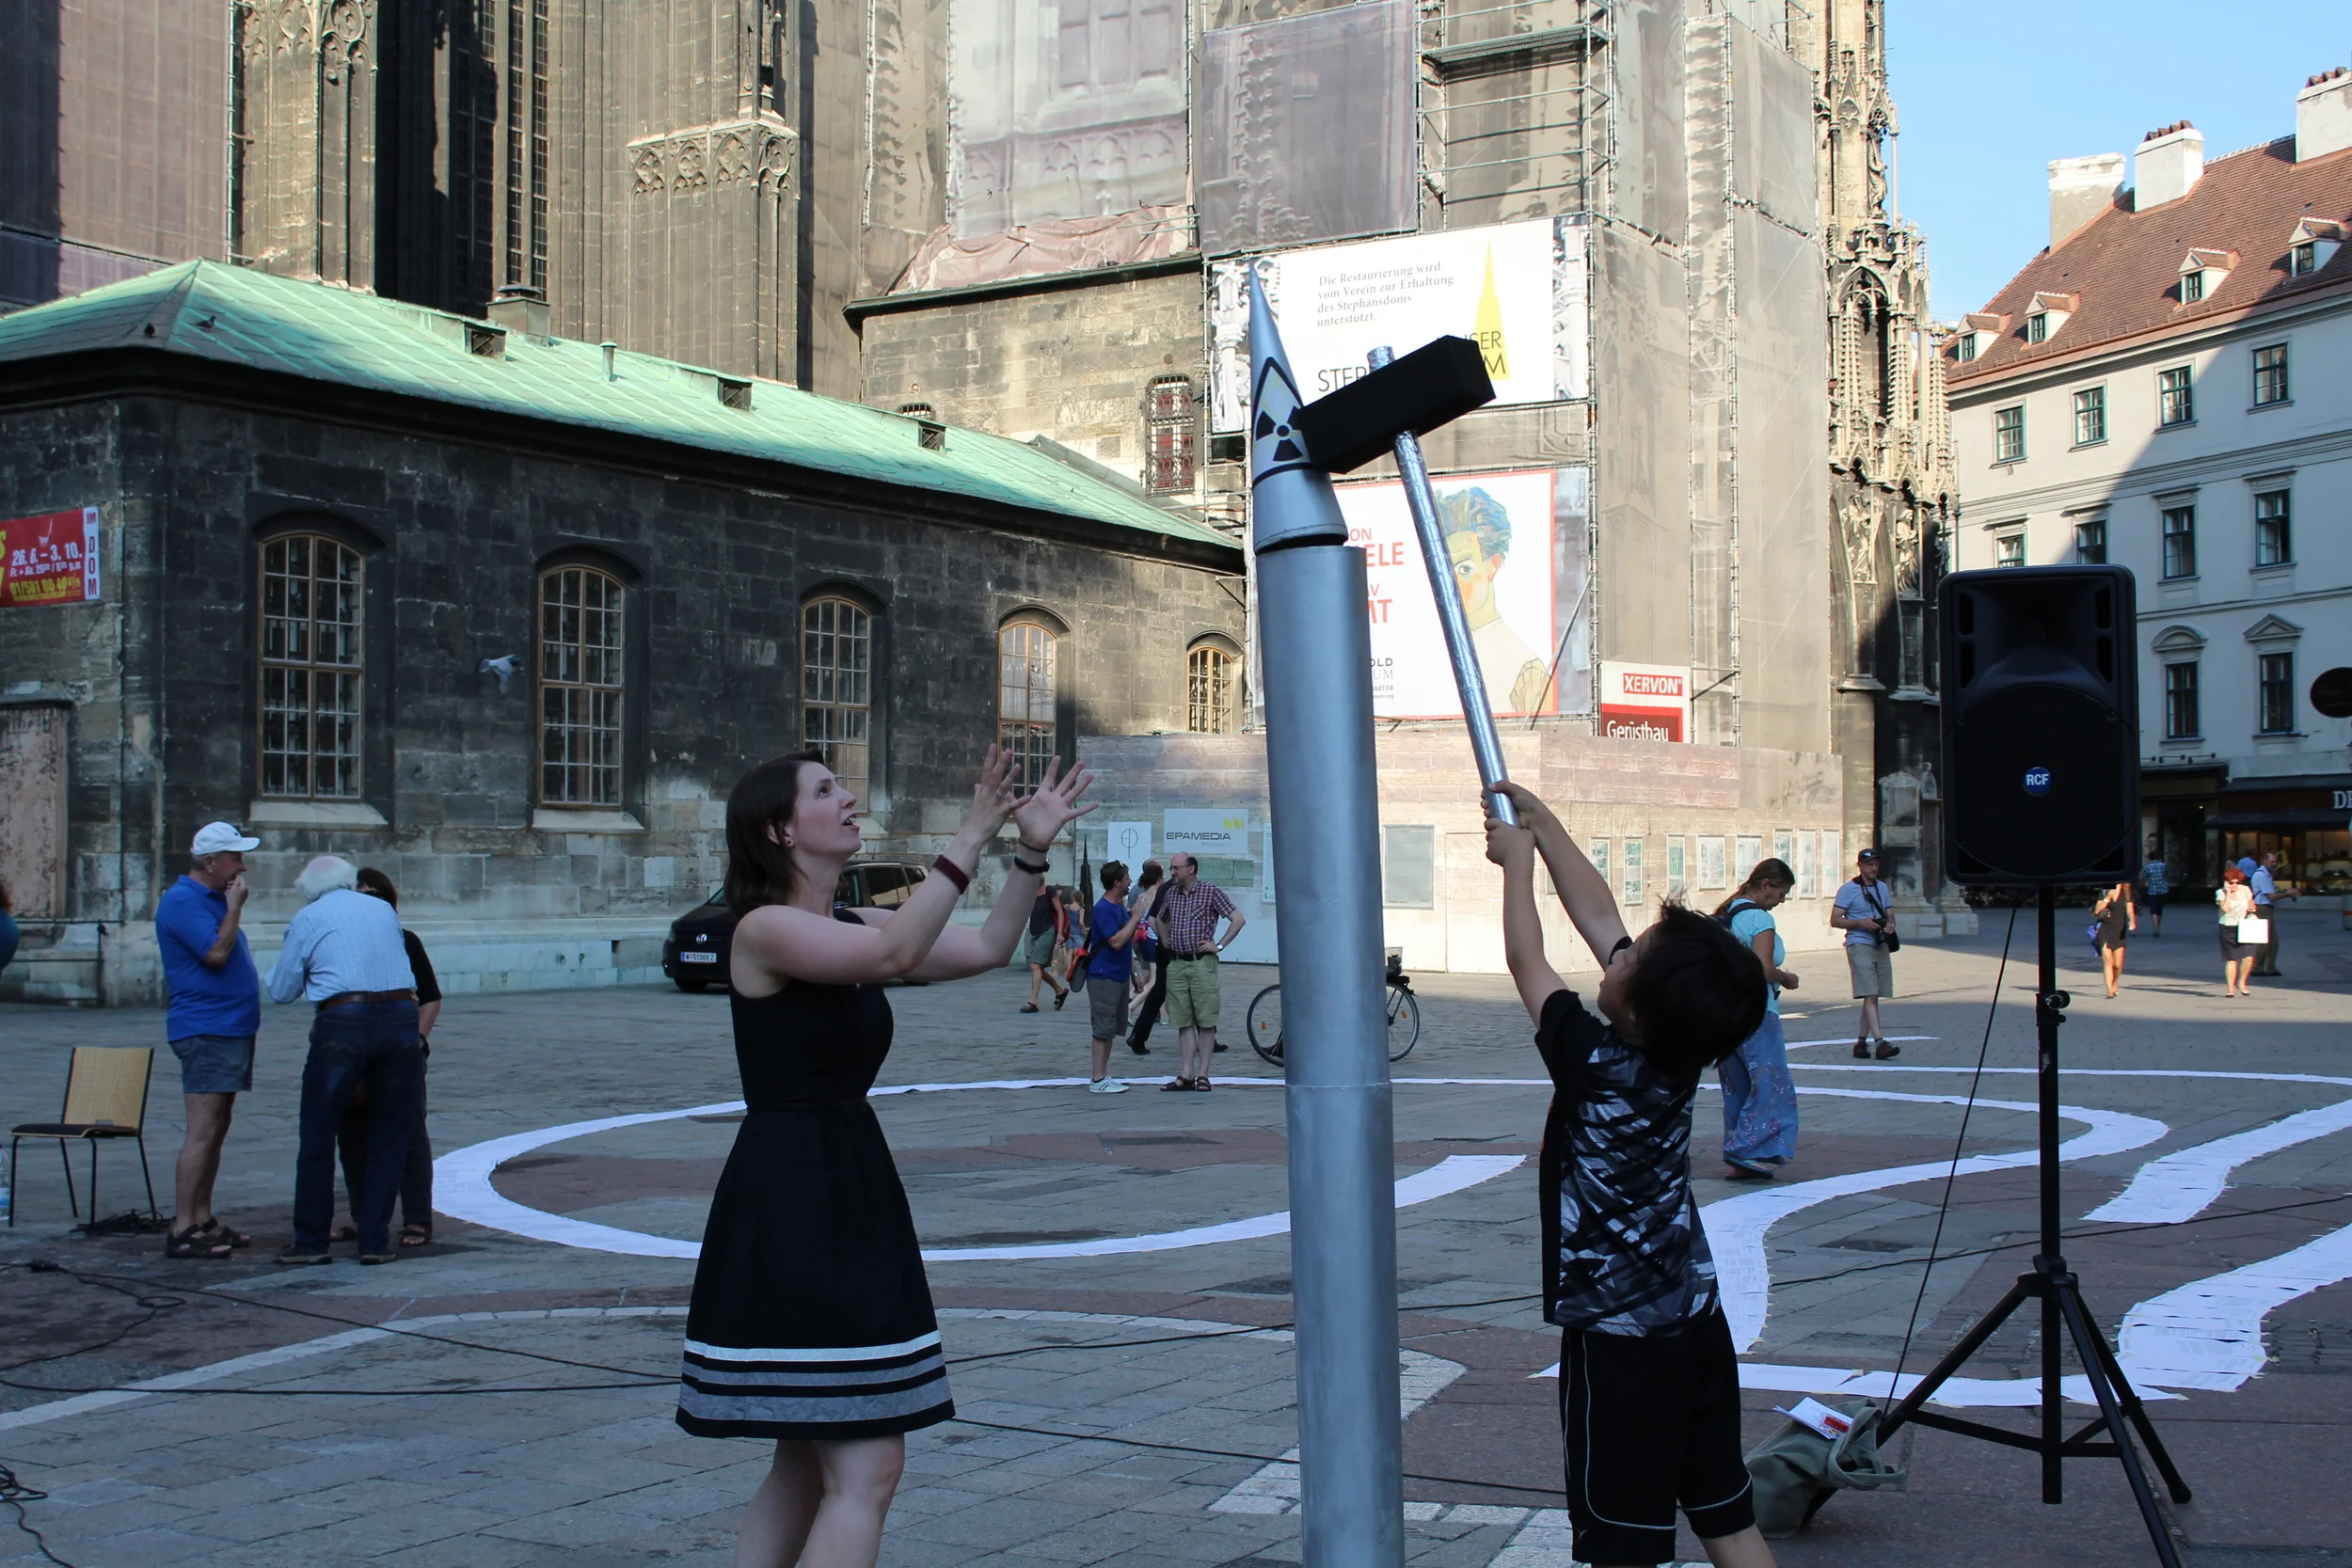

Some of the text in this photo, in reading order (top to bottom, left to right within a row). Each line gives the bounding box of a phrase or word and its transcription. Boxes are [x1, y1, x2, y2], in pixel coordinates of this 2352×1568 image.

[1319, 261, 1441, 286] Die Restaurierung wird
[1318, 276, 1454, 299] vom Verein zur Erhaltung
[1317, 294, 1412, 313] des Stephansdoms
[1317, 312, 1376, 327] unterstützt.
[1363, 542, 1404, 567] ELE
[2026, 773, 2049, 786] RCF
[1166, 832, 1232, 841] EPAMEDIA
